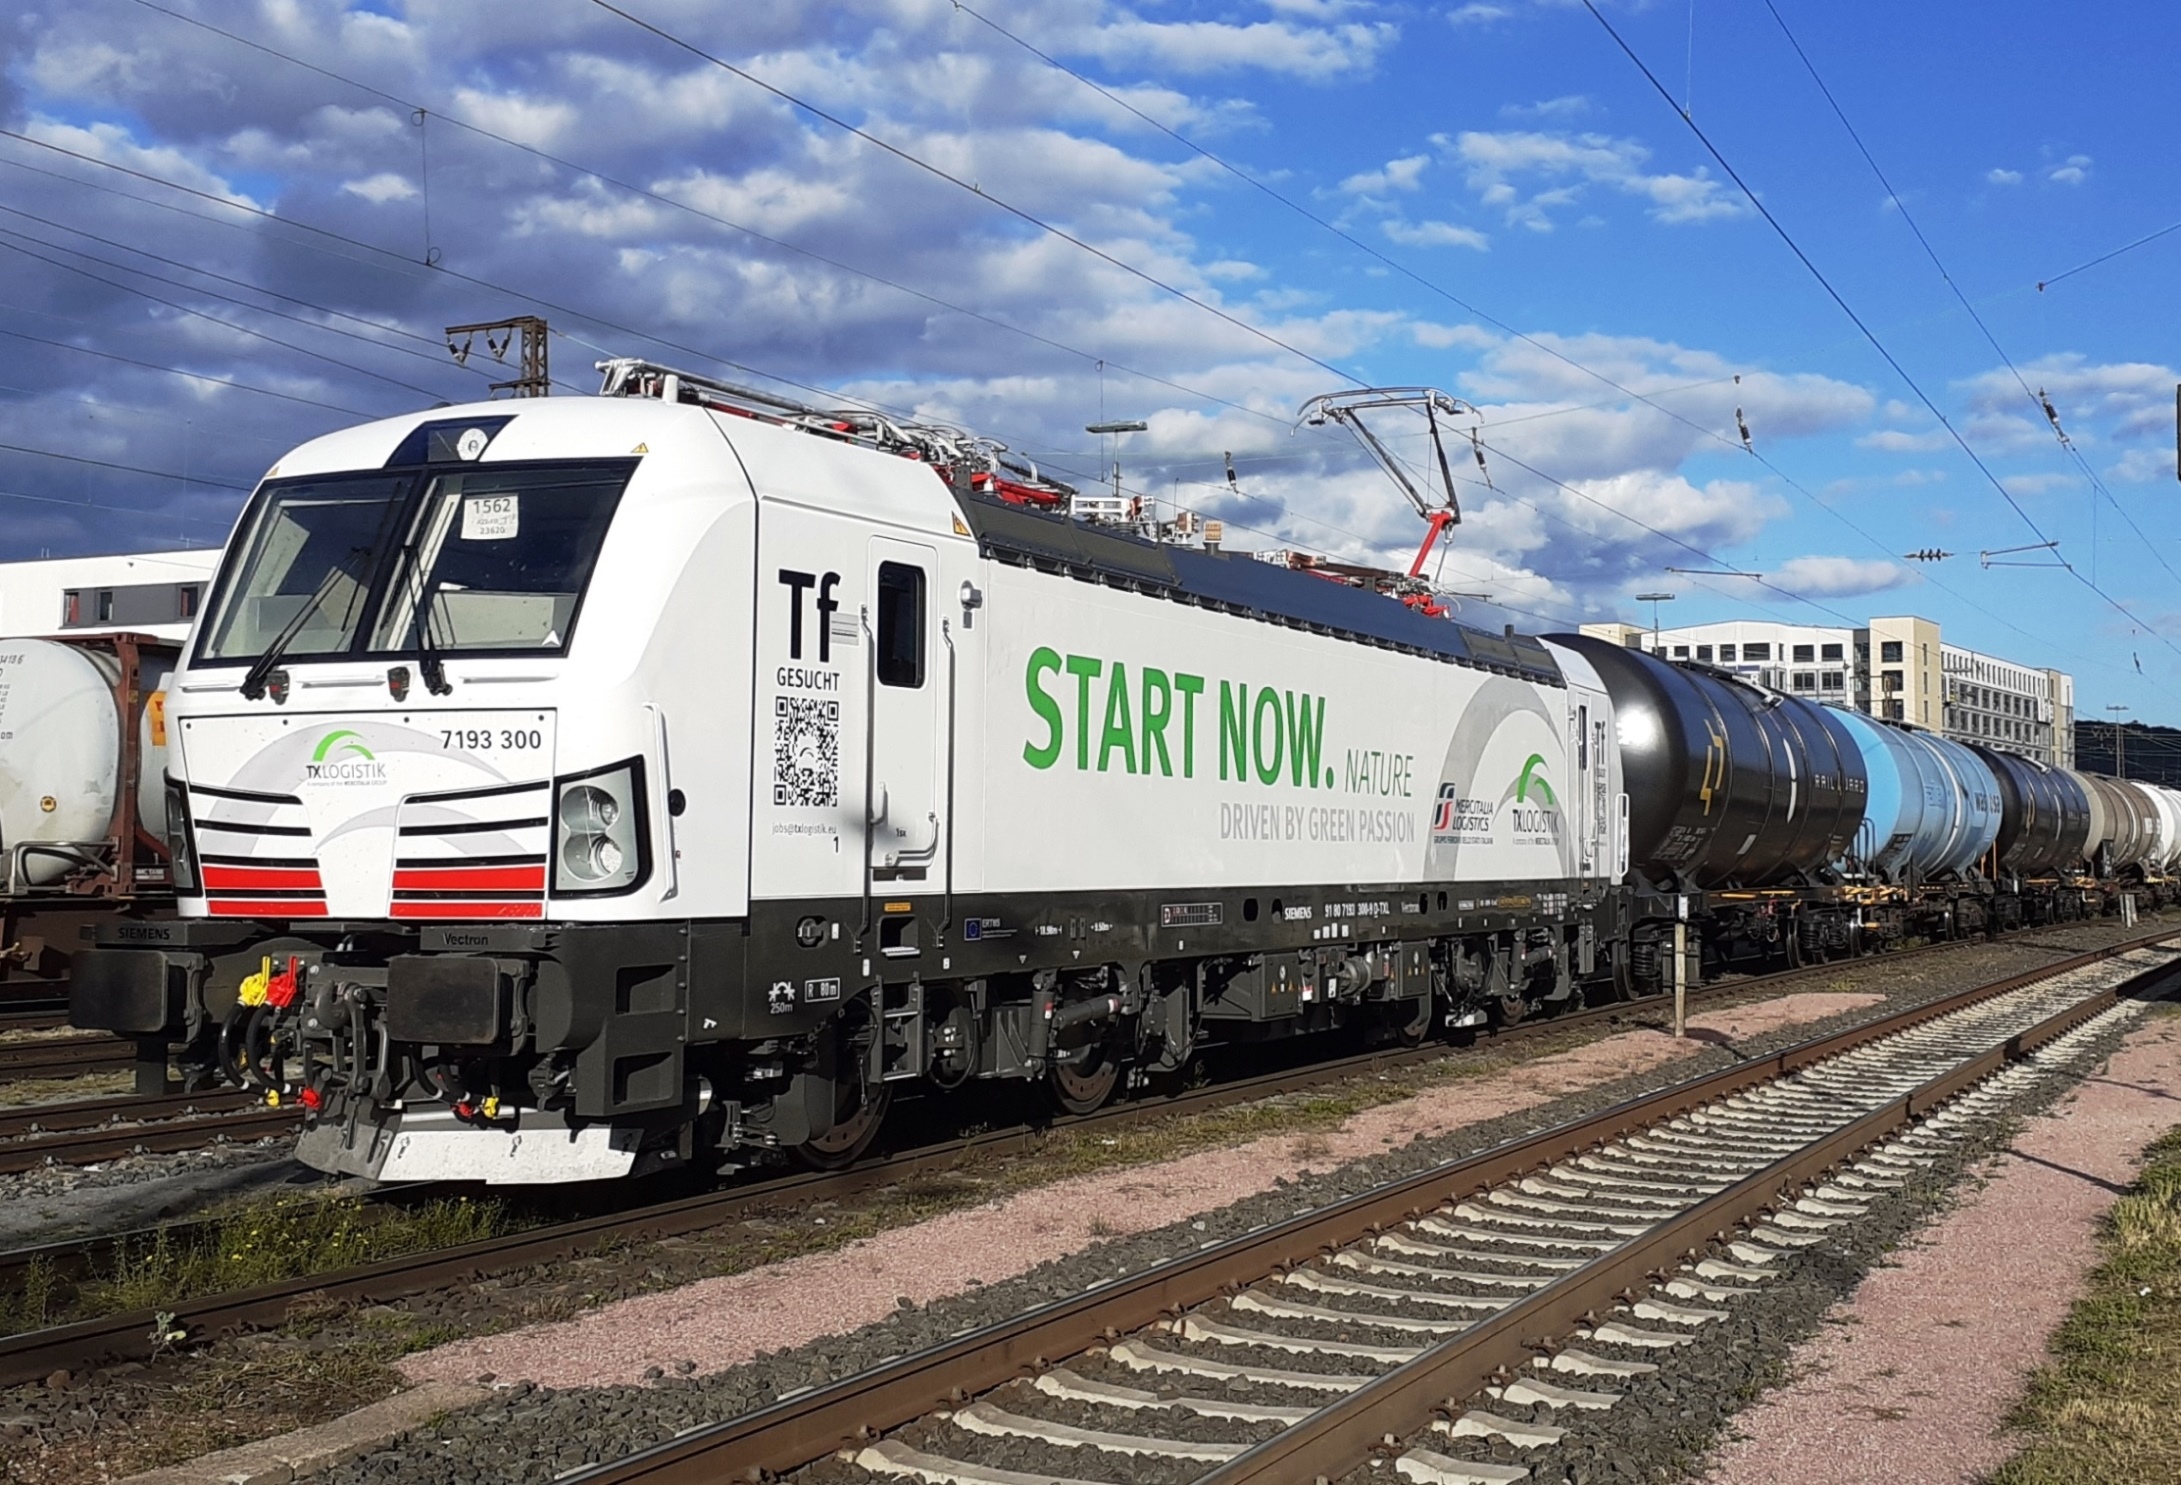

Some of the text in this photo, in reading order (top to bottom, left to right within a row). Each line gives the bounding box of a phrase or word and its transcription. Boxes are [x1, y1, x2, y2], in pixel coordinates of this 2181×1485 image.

[473, 498, 511, 514] 1562
[779, 568, 841, 663] Tf
[776, 667, 840, 692] GESUCHT
[1022, 646, 1414, 798] START NOW. NATURE
[441, 730, 542, 749] 7193 300
[1455, 798, 1493, 815] MERCITALIA
[1220, 802, 1415, 843] DRIVEN BY GREEN PASSION
[1452, 815, 1489, 832] LOGISTICS
[833, 836, 839, 853] 1
[1284, 906, 1312, 920] SIEMENS
[1324, 903, 1333, 918] 91
[118, 927, 171, 940] SIEMENS
[443, 932, 489, 946] Vectron
[808, 982, 837, 998] R 80m
[770, 1001, 793, 1014] 250m
